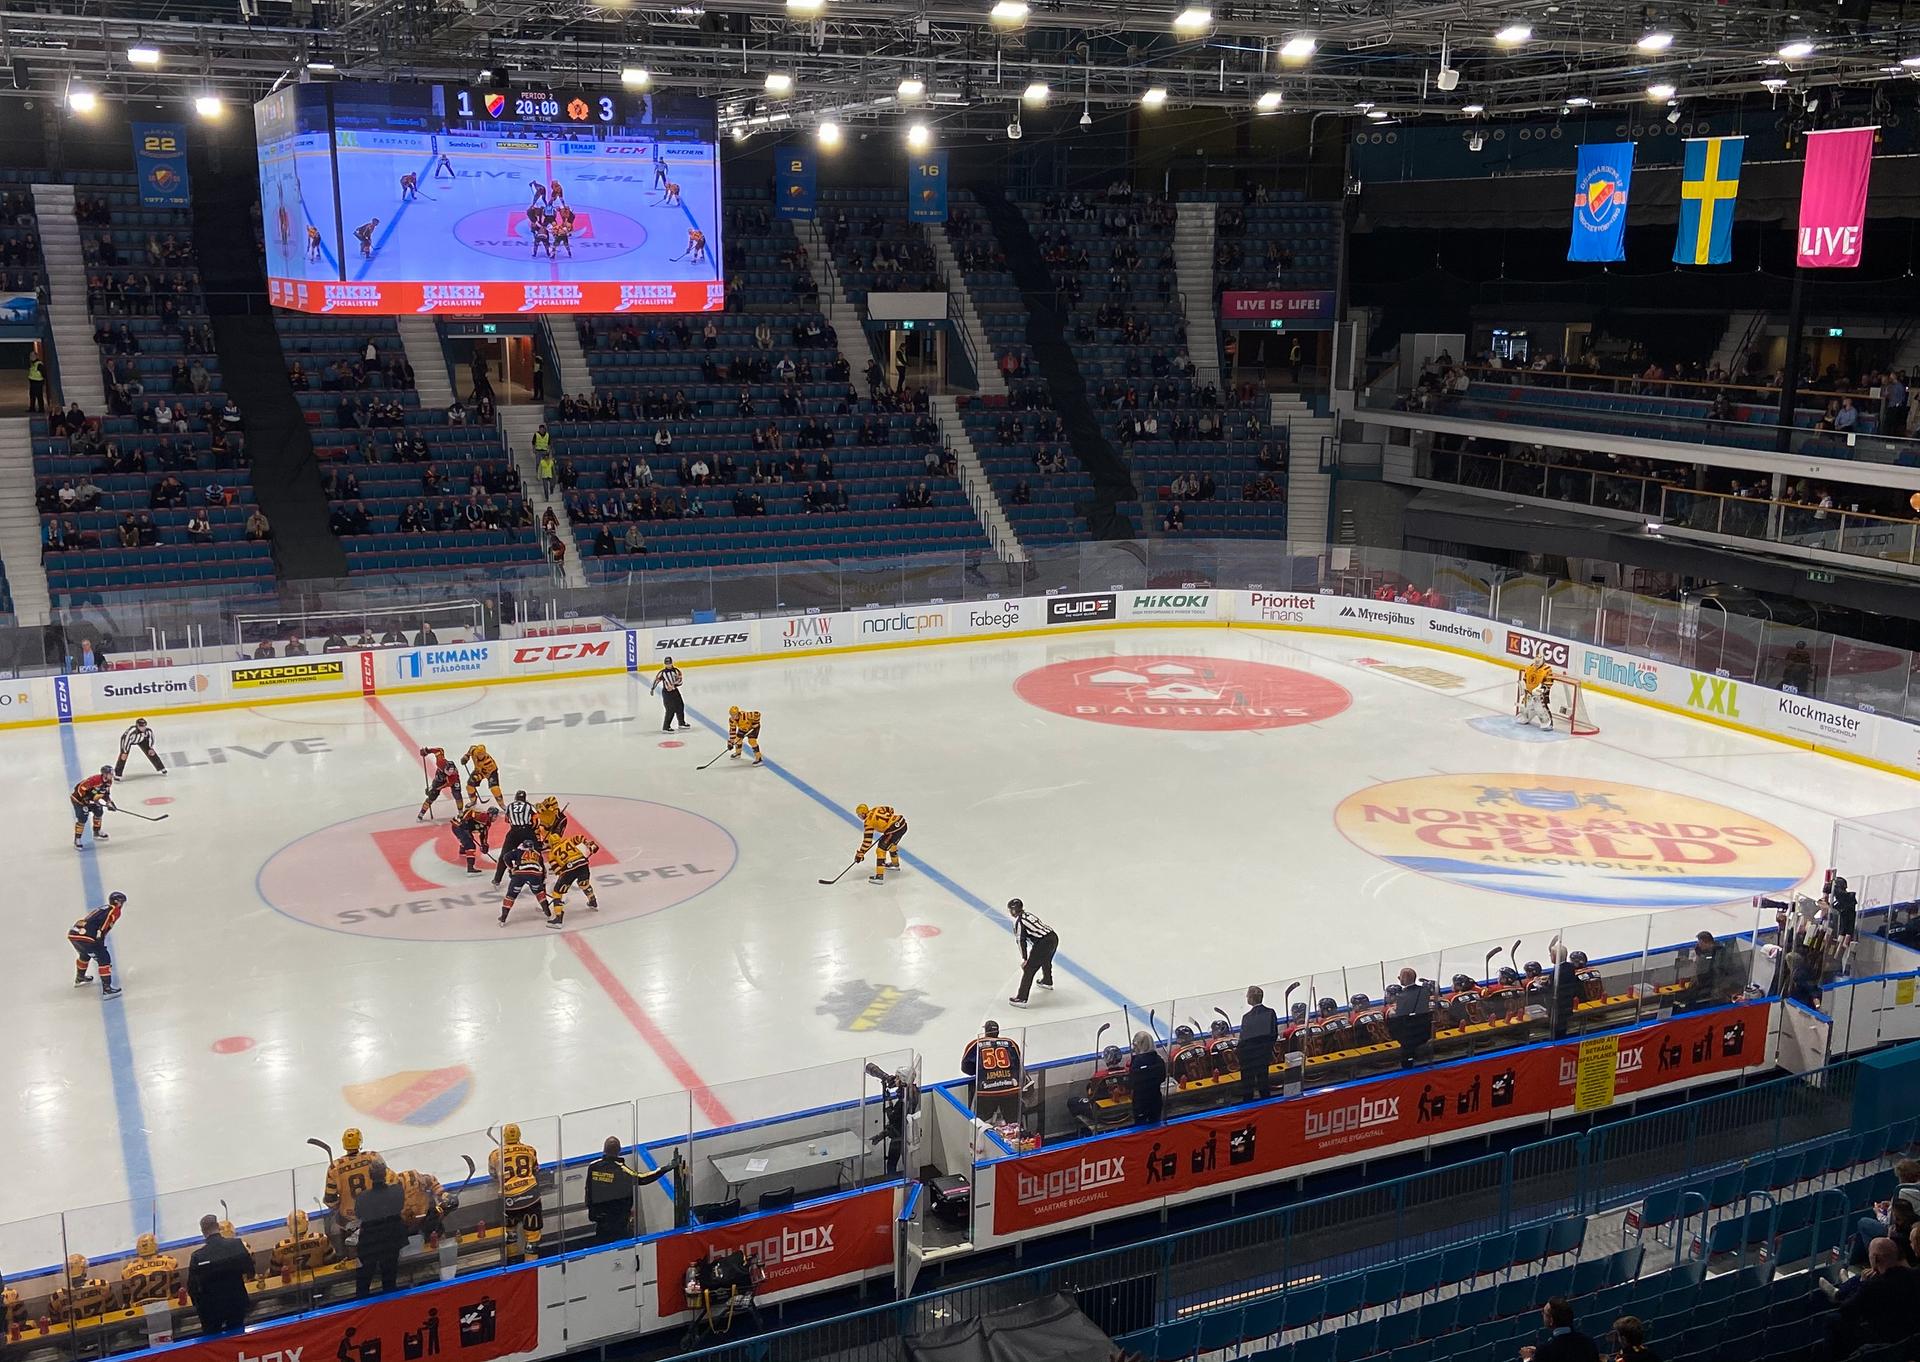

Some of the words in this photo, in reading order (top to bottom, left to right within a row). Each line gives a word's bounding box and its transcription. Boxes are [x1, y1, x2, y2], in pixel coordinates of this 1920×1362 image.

[457, 91, 473, 116] 1
[521, 92, 547, 100] PERIOD
[515, 100, 559, 116] 20:00
[598, 97, 613, 121] 3
[144, 136, 176, 151] 22
[605, 146, 648, 155] CCM
[456, 170, 521, 179] LIVE
[791, 160, 803, 172] 2
[918, 165, 940, 177] 16
[575, 174, 644, 183] SHL
[579, 241, 632, 249] SPEL
[1800, 225, 1859, 257] LIVE
[324, 285, 381, 300] KAKEL
[422, 285, 485, 300] KAKEL
[523, 285, 583, 299] KAKEL
[620, 285, 677, 299] KAKEL
[1236, 299, 1266, 311] LIVE
[1270, 299, 1283, 310] IS
[1288, 298, 1320, 310] LIFE!
[1053, 600, 1109, 615] GUIDE
[1133, 595, 1209, 608] HiKOKI
[1250, 593, 1316, 610] Prioritet
[863, 612, 944, 634] nordicpm
[970, 611, 1019, 628] Fabege
[1261, 607, 1304, 622] Finans
[1357, 607, 1415, 626] Myresjöhus
[782, 617, 833, 638] JMW
[1428, 619, 1481, 640] Sundström
[655, 632, 750, 650] SKECHERS
[815, 630, 833, 645] AB
[426, 647, 488, 665] EKMANS
[512, 640, 611, 664] CCM
[627, 633, 636, 664] CCM
[1520, 635, 1568, 665] BYGG
[235, 663, 340, 681] HYRPOOLEN
[364, 654, 373, 686] CCM
[432, 662, 481, 674] STÅLDÖRRAR
[1583, 650, 1658, 693] Flinks
[1637, 661, 1658, 673] JÄRN
[59, 680, 69, 713] CCM
[103, 680, 188, 698] Sundström
[1686, 671, 1740, 719] XXL
[1075, 705, 1309, 718] BAUHAUS
[1778, 697, 1861, 731] Klockmaster
[470, 710, 637, 737] SHL
[1819, 724, 1857, 739] STOCKHOLM
[165, 736, 335, 768] LIVE
[513, 803, 524, 813] 27
[1361, 803, 1776, 848] NORRLANDS
[553, 841, 577, 862] 34
[1414, 823, 1738, 866] GULD
[1481, 853, 1686, 875] ALKOHOLFRI
[602, 861, 715, 887] SPEL
[981, 1047, 1011, 1070] 59
[1304, 1096, 1400, 1139] byggbox
[503, 1155, 530, 1184] 58
[1018, 1155, 1125, 1205] byggbox
[1034, 1199, 1068, 1215] SMARTARE
[1067, 1191, 1109, 1207] BYGGAVFALL
[769, 1261, 817, 1279] BYGGAVFALL
[132, 1270, 168, 1300] 22
